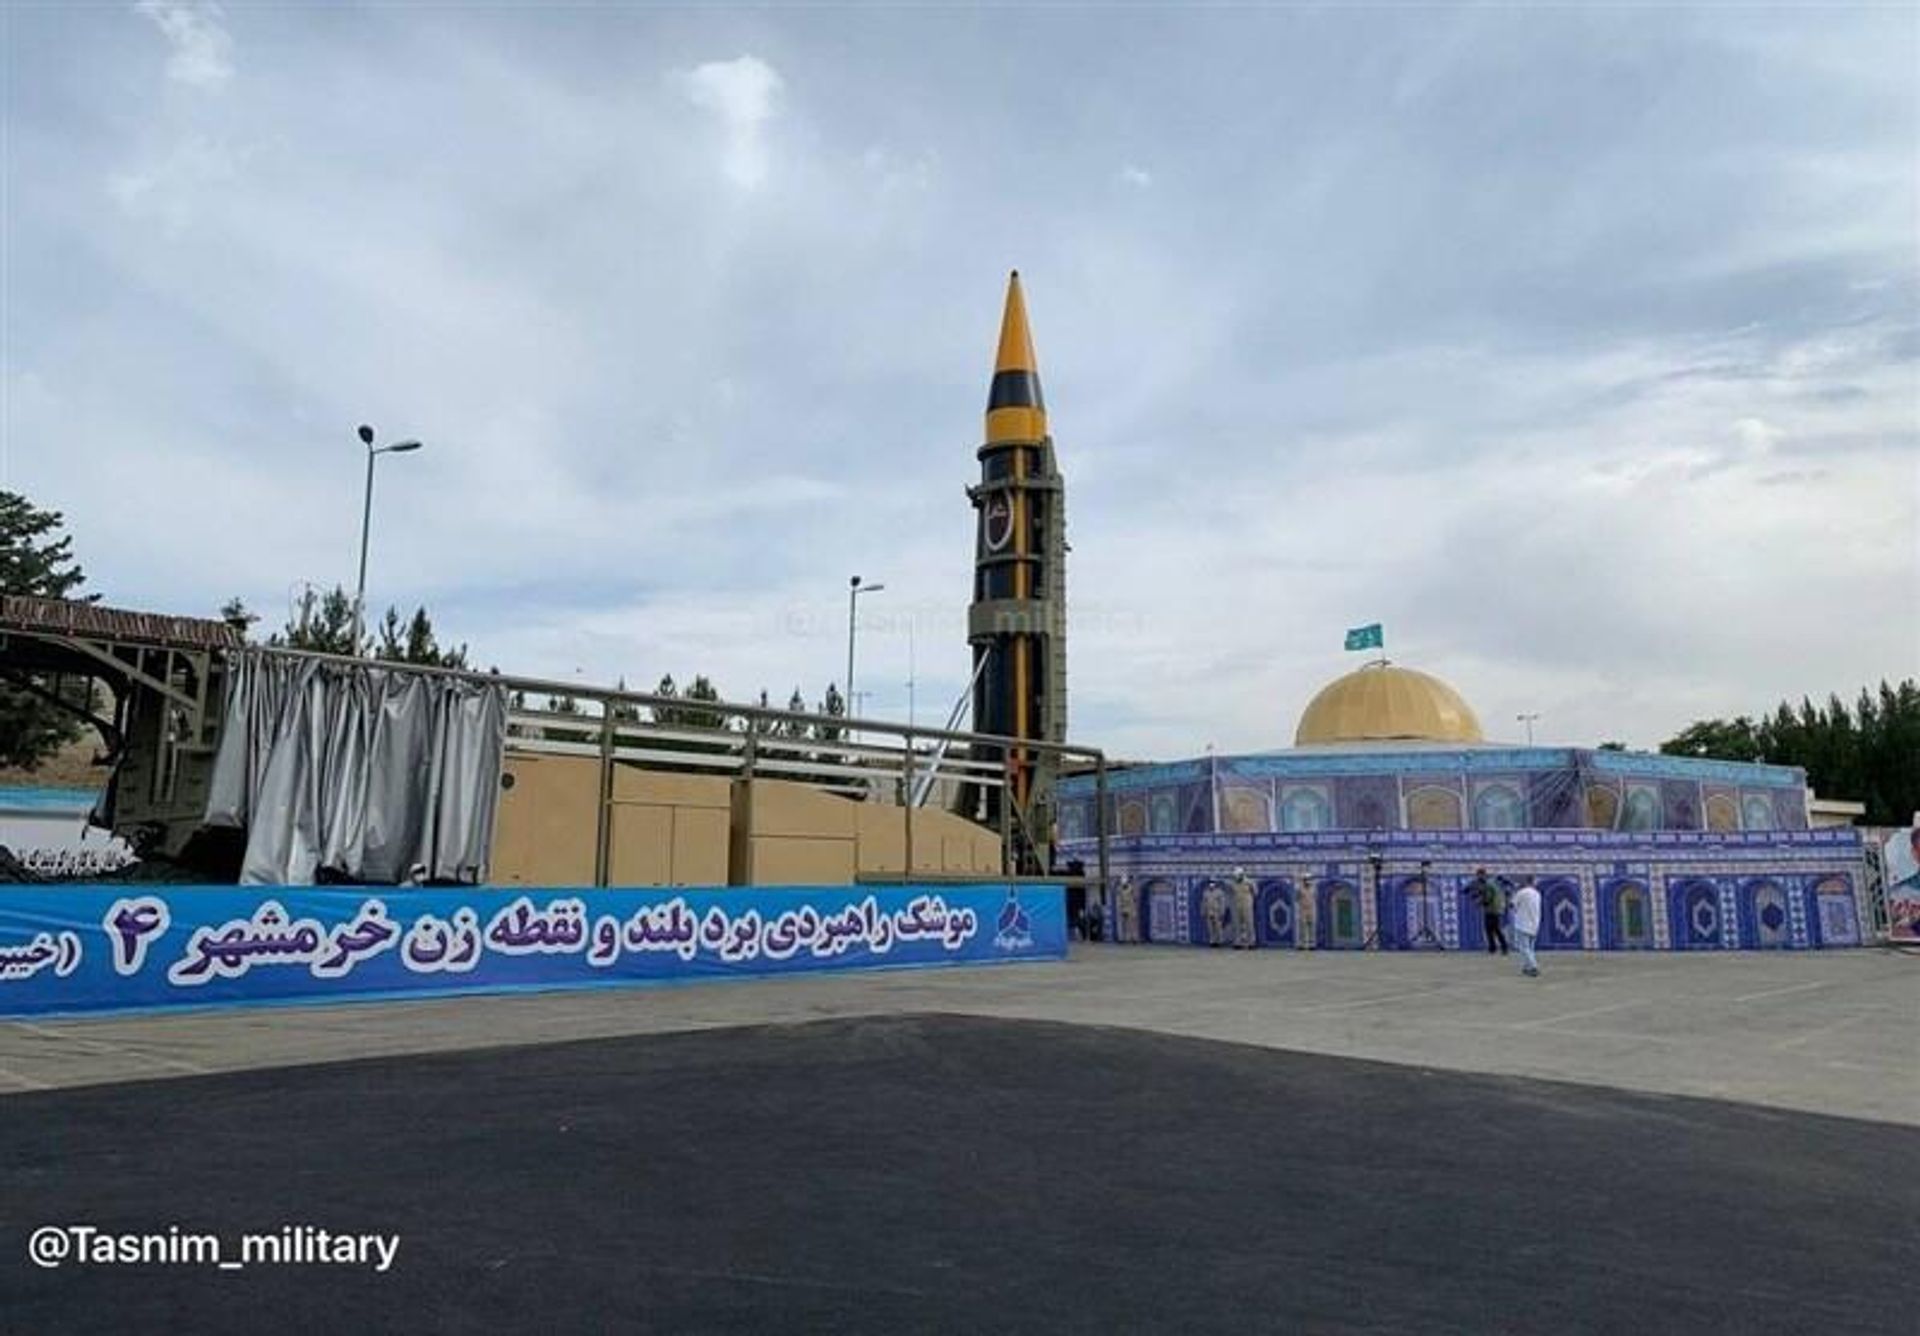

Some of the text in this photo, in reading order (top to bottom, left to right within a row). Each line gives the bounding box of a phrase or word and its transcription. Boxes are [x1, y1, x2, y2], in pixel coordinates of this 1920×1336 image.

[105, 898, 168, 973] ۴
[170, 901, 399, 983] خرمشهر
[589, 917, 618, 964] و
[626, 899, 697, 959] بلند
[702, 908, 760, 958] برد
[765, 897, 890, 955] راهبردی
[897, 898, 976, 946] موشک
